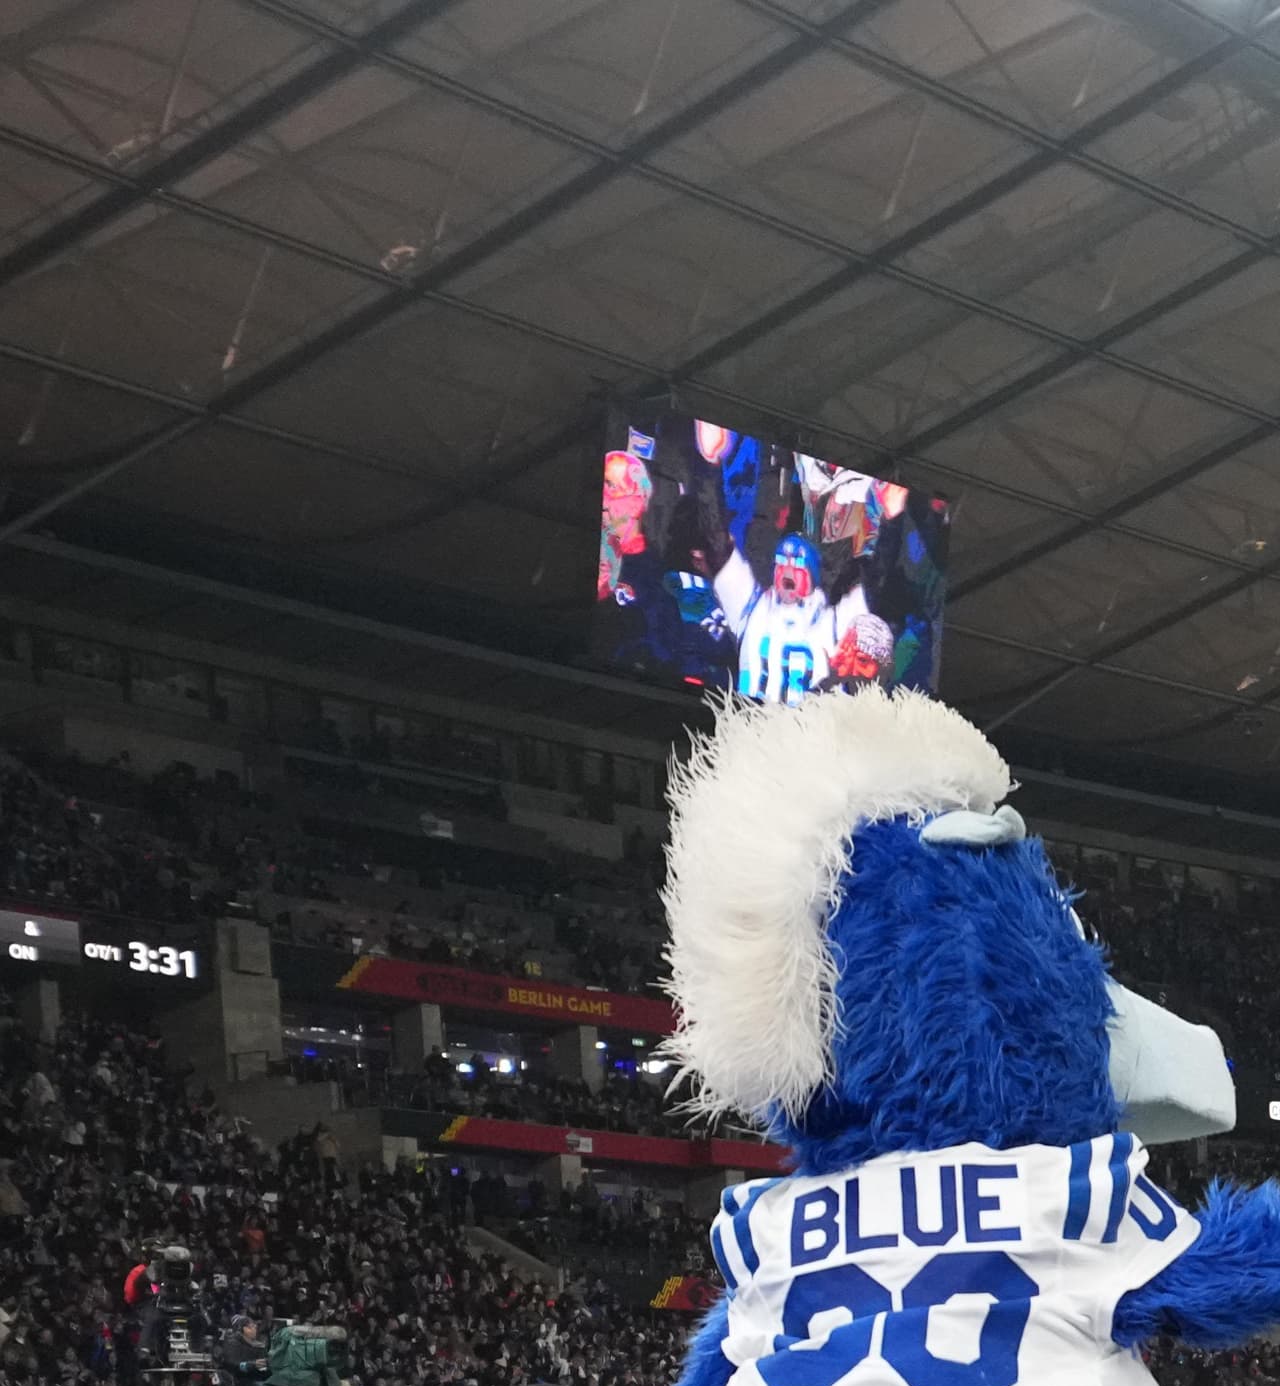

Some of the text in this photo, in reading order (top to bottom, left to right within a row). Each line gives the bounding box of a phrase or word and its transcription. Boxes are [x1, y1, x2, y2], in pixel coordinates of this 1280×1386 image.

[128, 942, 197, 979] 3:31
[508, 987, 563, 1008] BERLIN
[566, 998, 612, 1017] GAME
[790, 1164, 1023, 1268] BLUE
